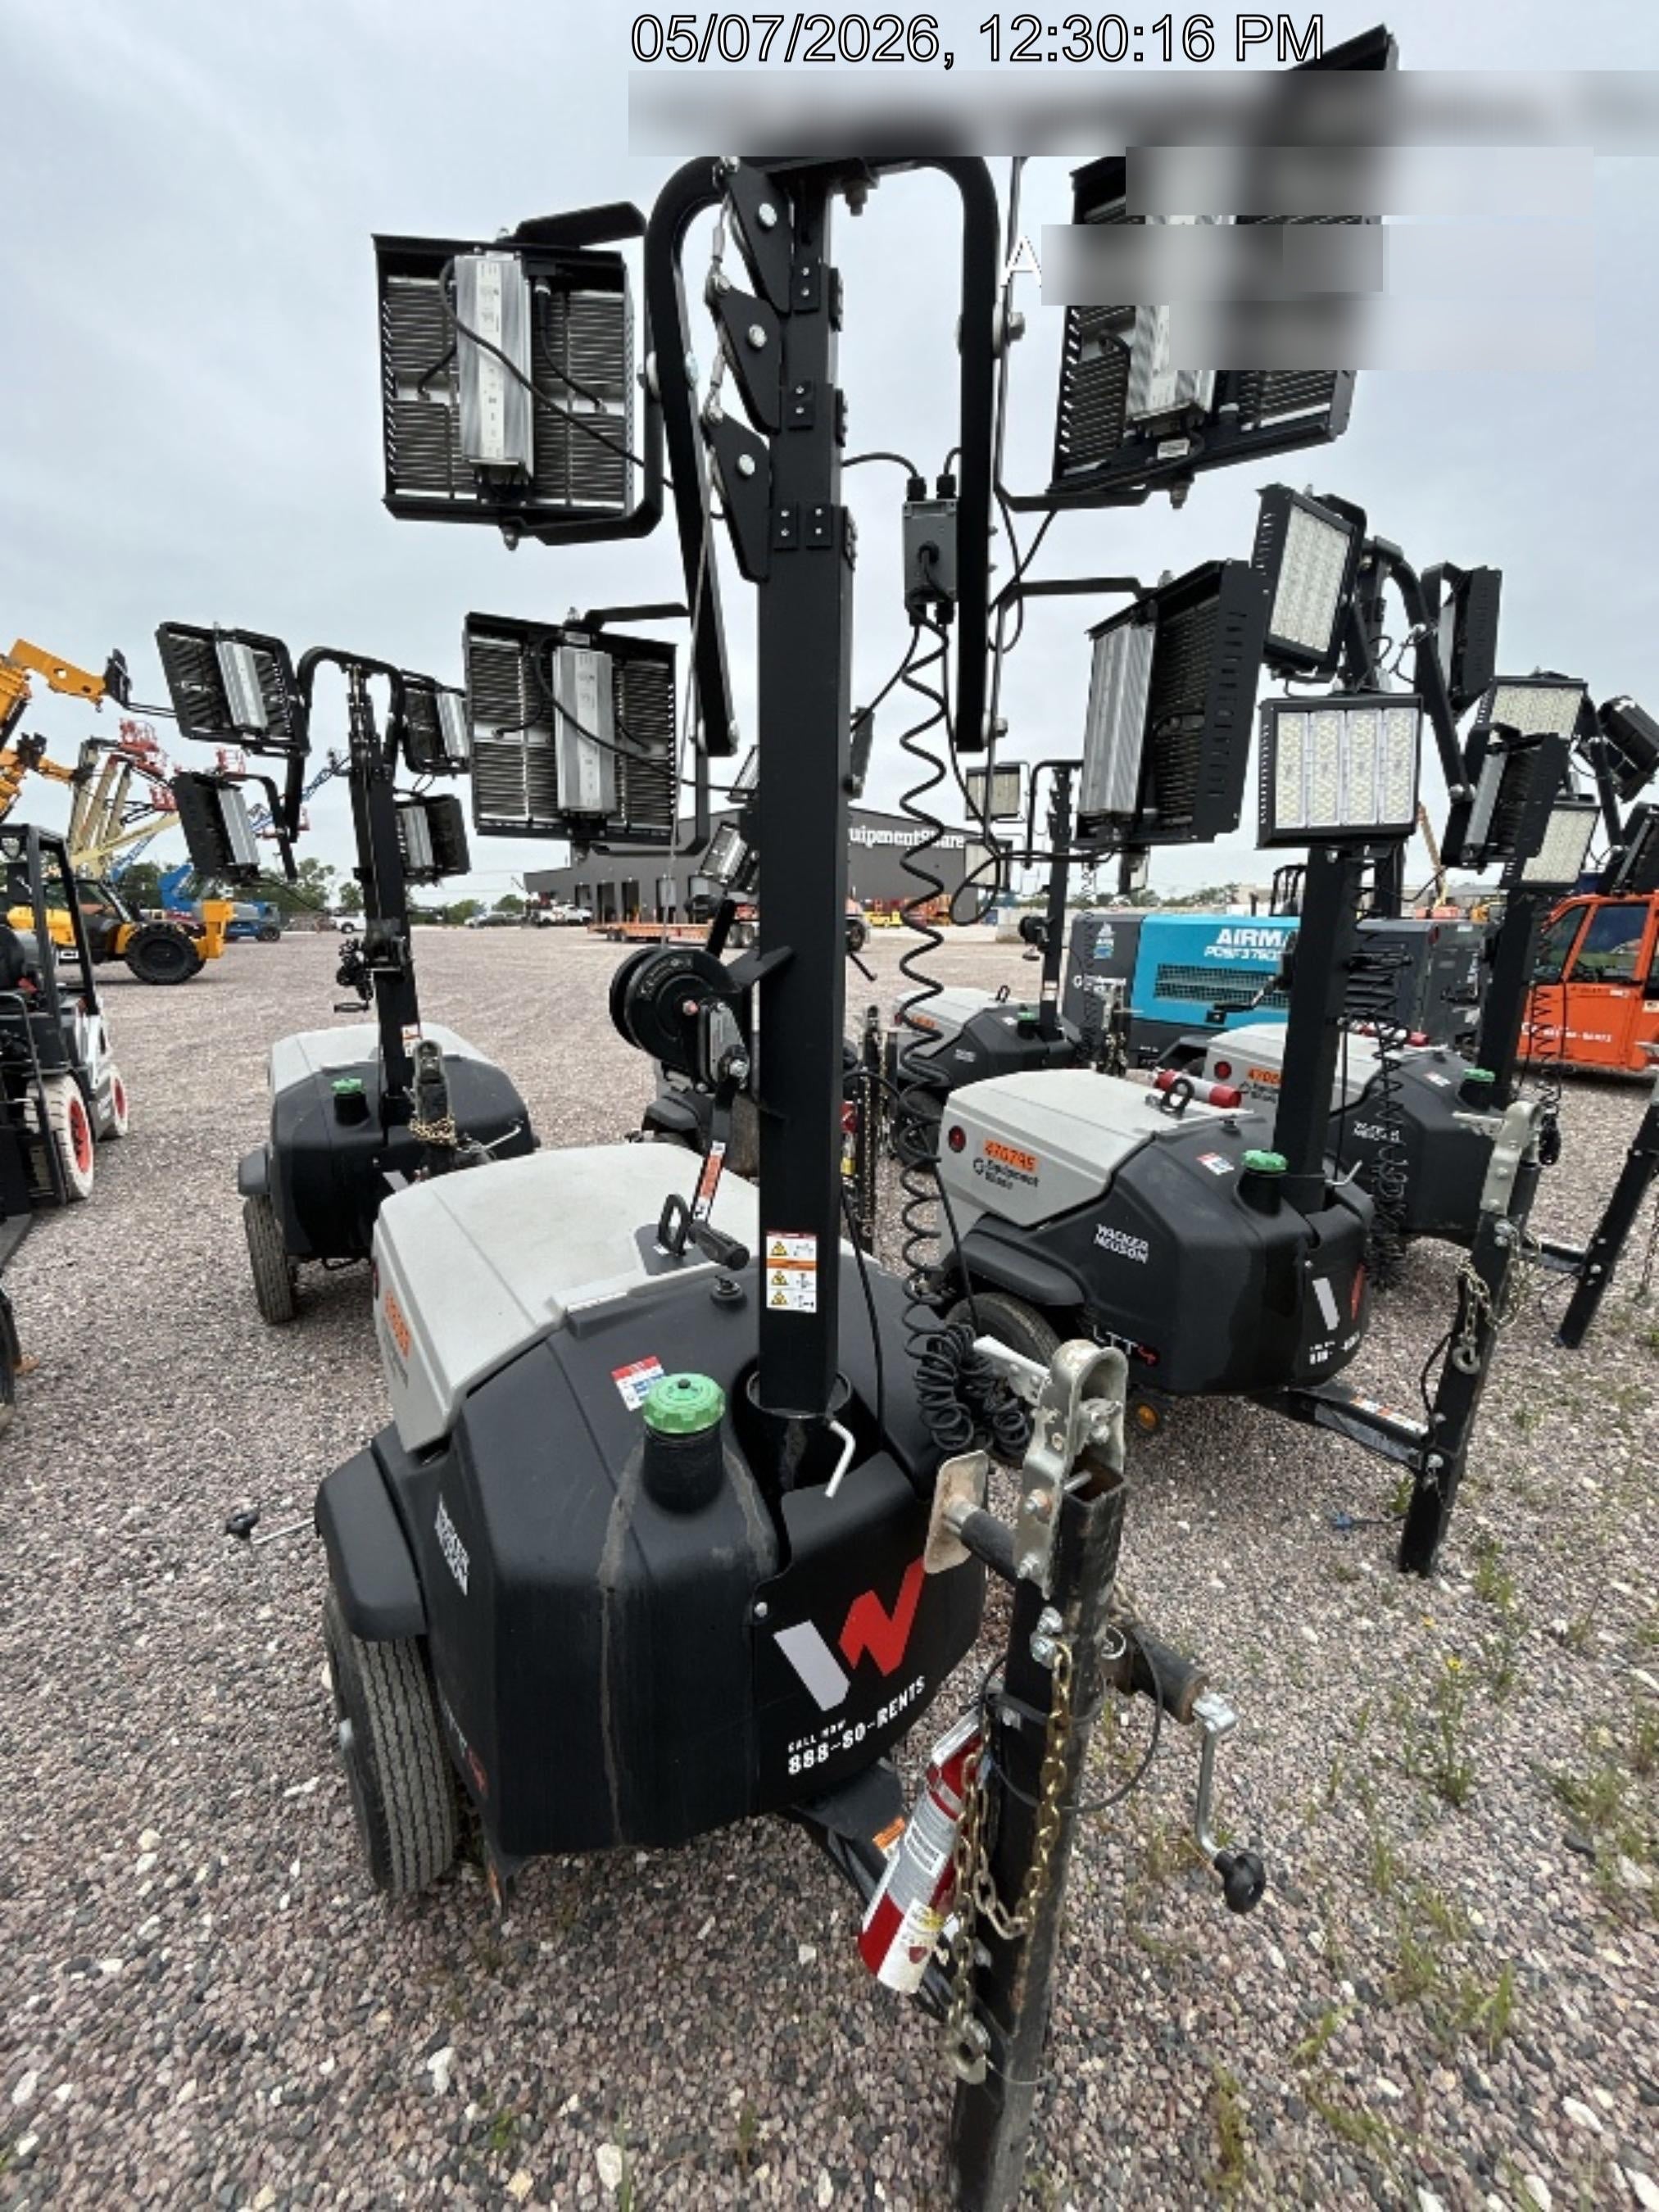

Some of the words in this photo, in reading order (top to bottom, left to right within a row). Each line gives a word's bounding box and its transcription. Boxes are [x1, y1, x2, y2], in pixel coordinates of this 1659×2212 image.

[1093, 1233, 1149, 1263] NEUSON
[1095, 1223, 1149, 1251] WACKER
[788, 1734, 816, 1753] CALL
